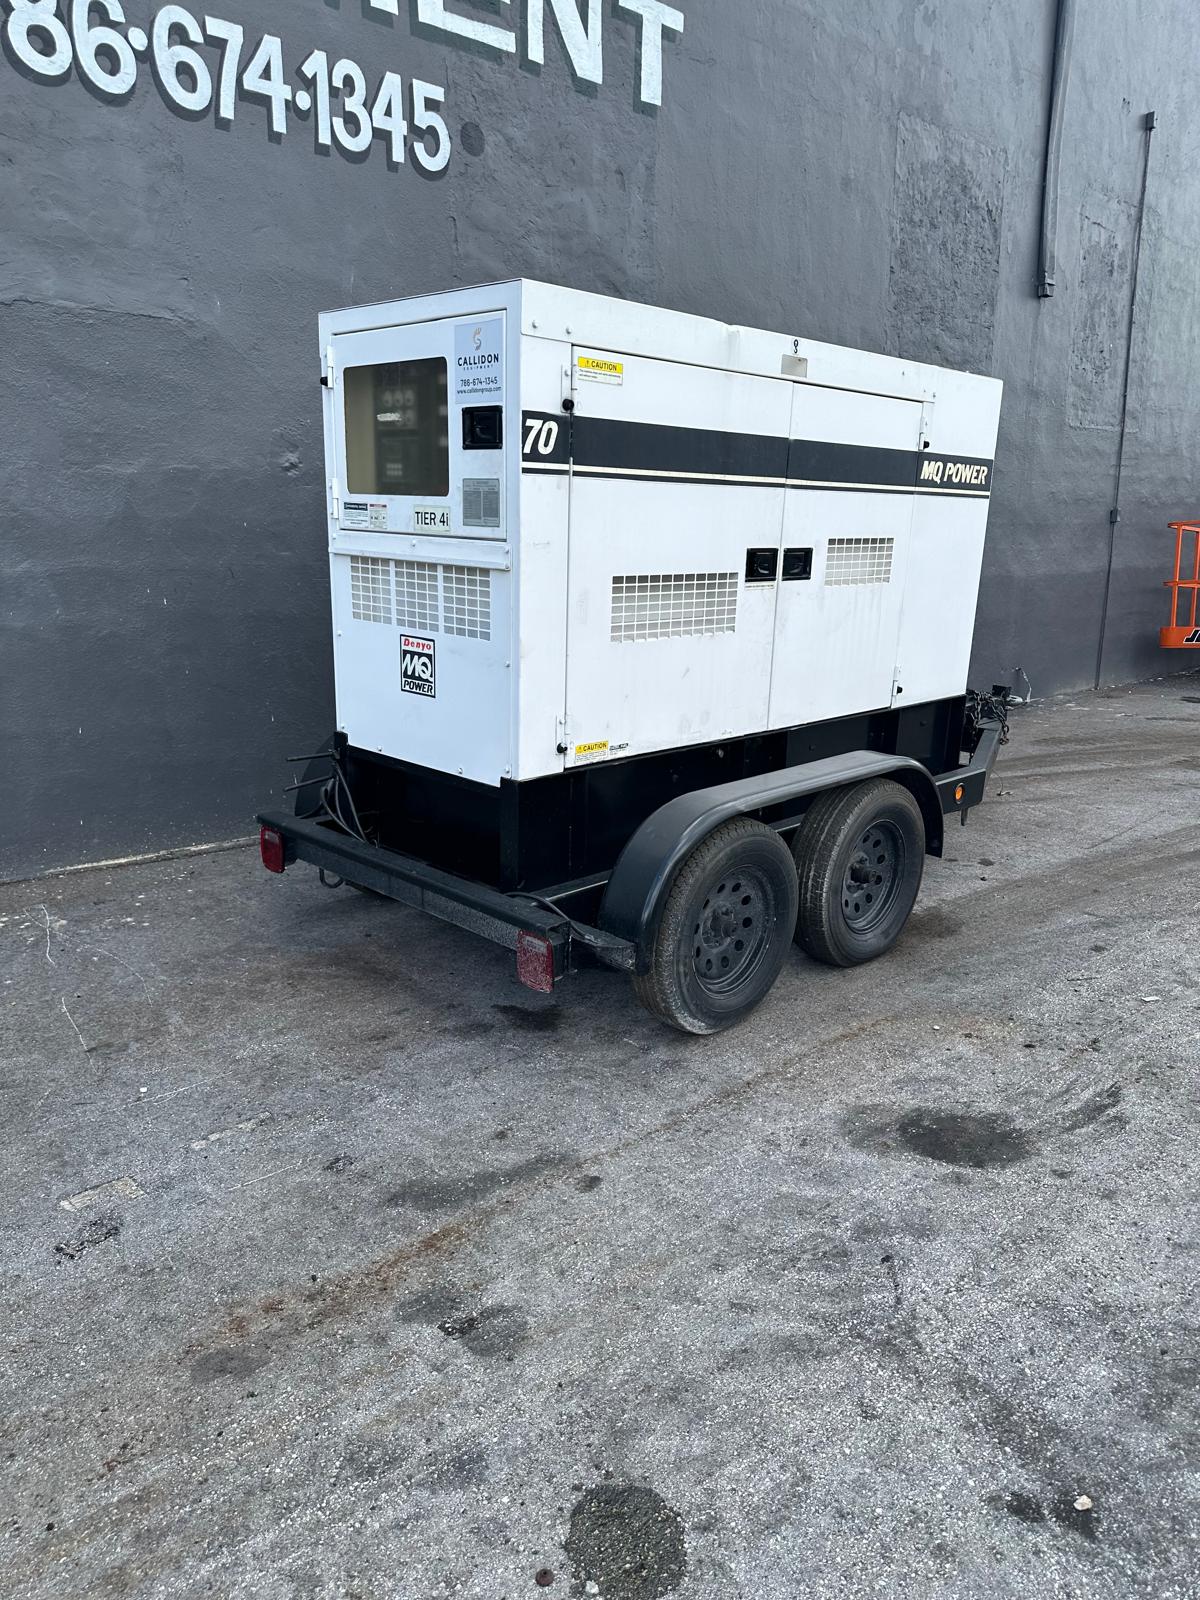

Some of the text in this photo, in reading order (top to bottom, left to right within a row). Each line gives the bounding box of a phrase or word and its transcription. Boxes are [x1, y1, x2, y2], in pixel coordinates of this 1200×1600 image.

[457, 353, 499, 367] CALLIDON
[591, 360, 618, 371] CAUTION
[523, 418, 559, 455] 70
[920, 460, 988, 484] MQ POWER
[415, 511, 449, 526] TIER 4i
[403, 638, 432, 651] Denyo
[402, 653, 433, 681] MQ
[403, 679, 433, 694] POWER
[583, 742, 607, 751] CAUTION
